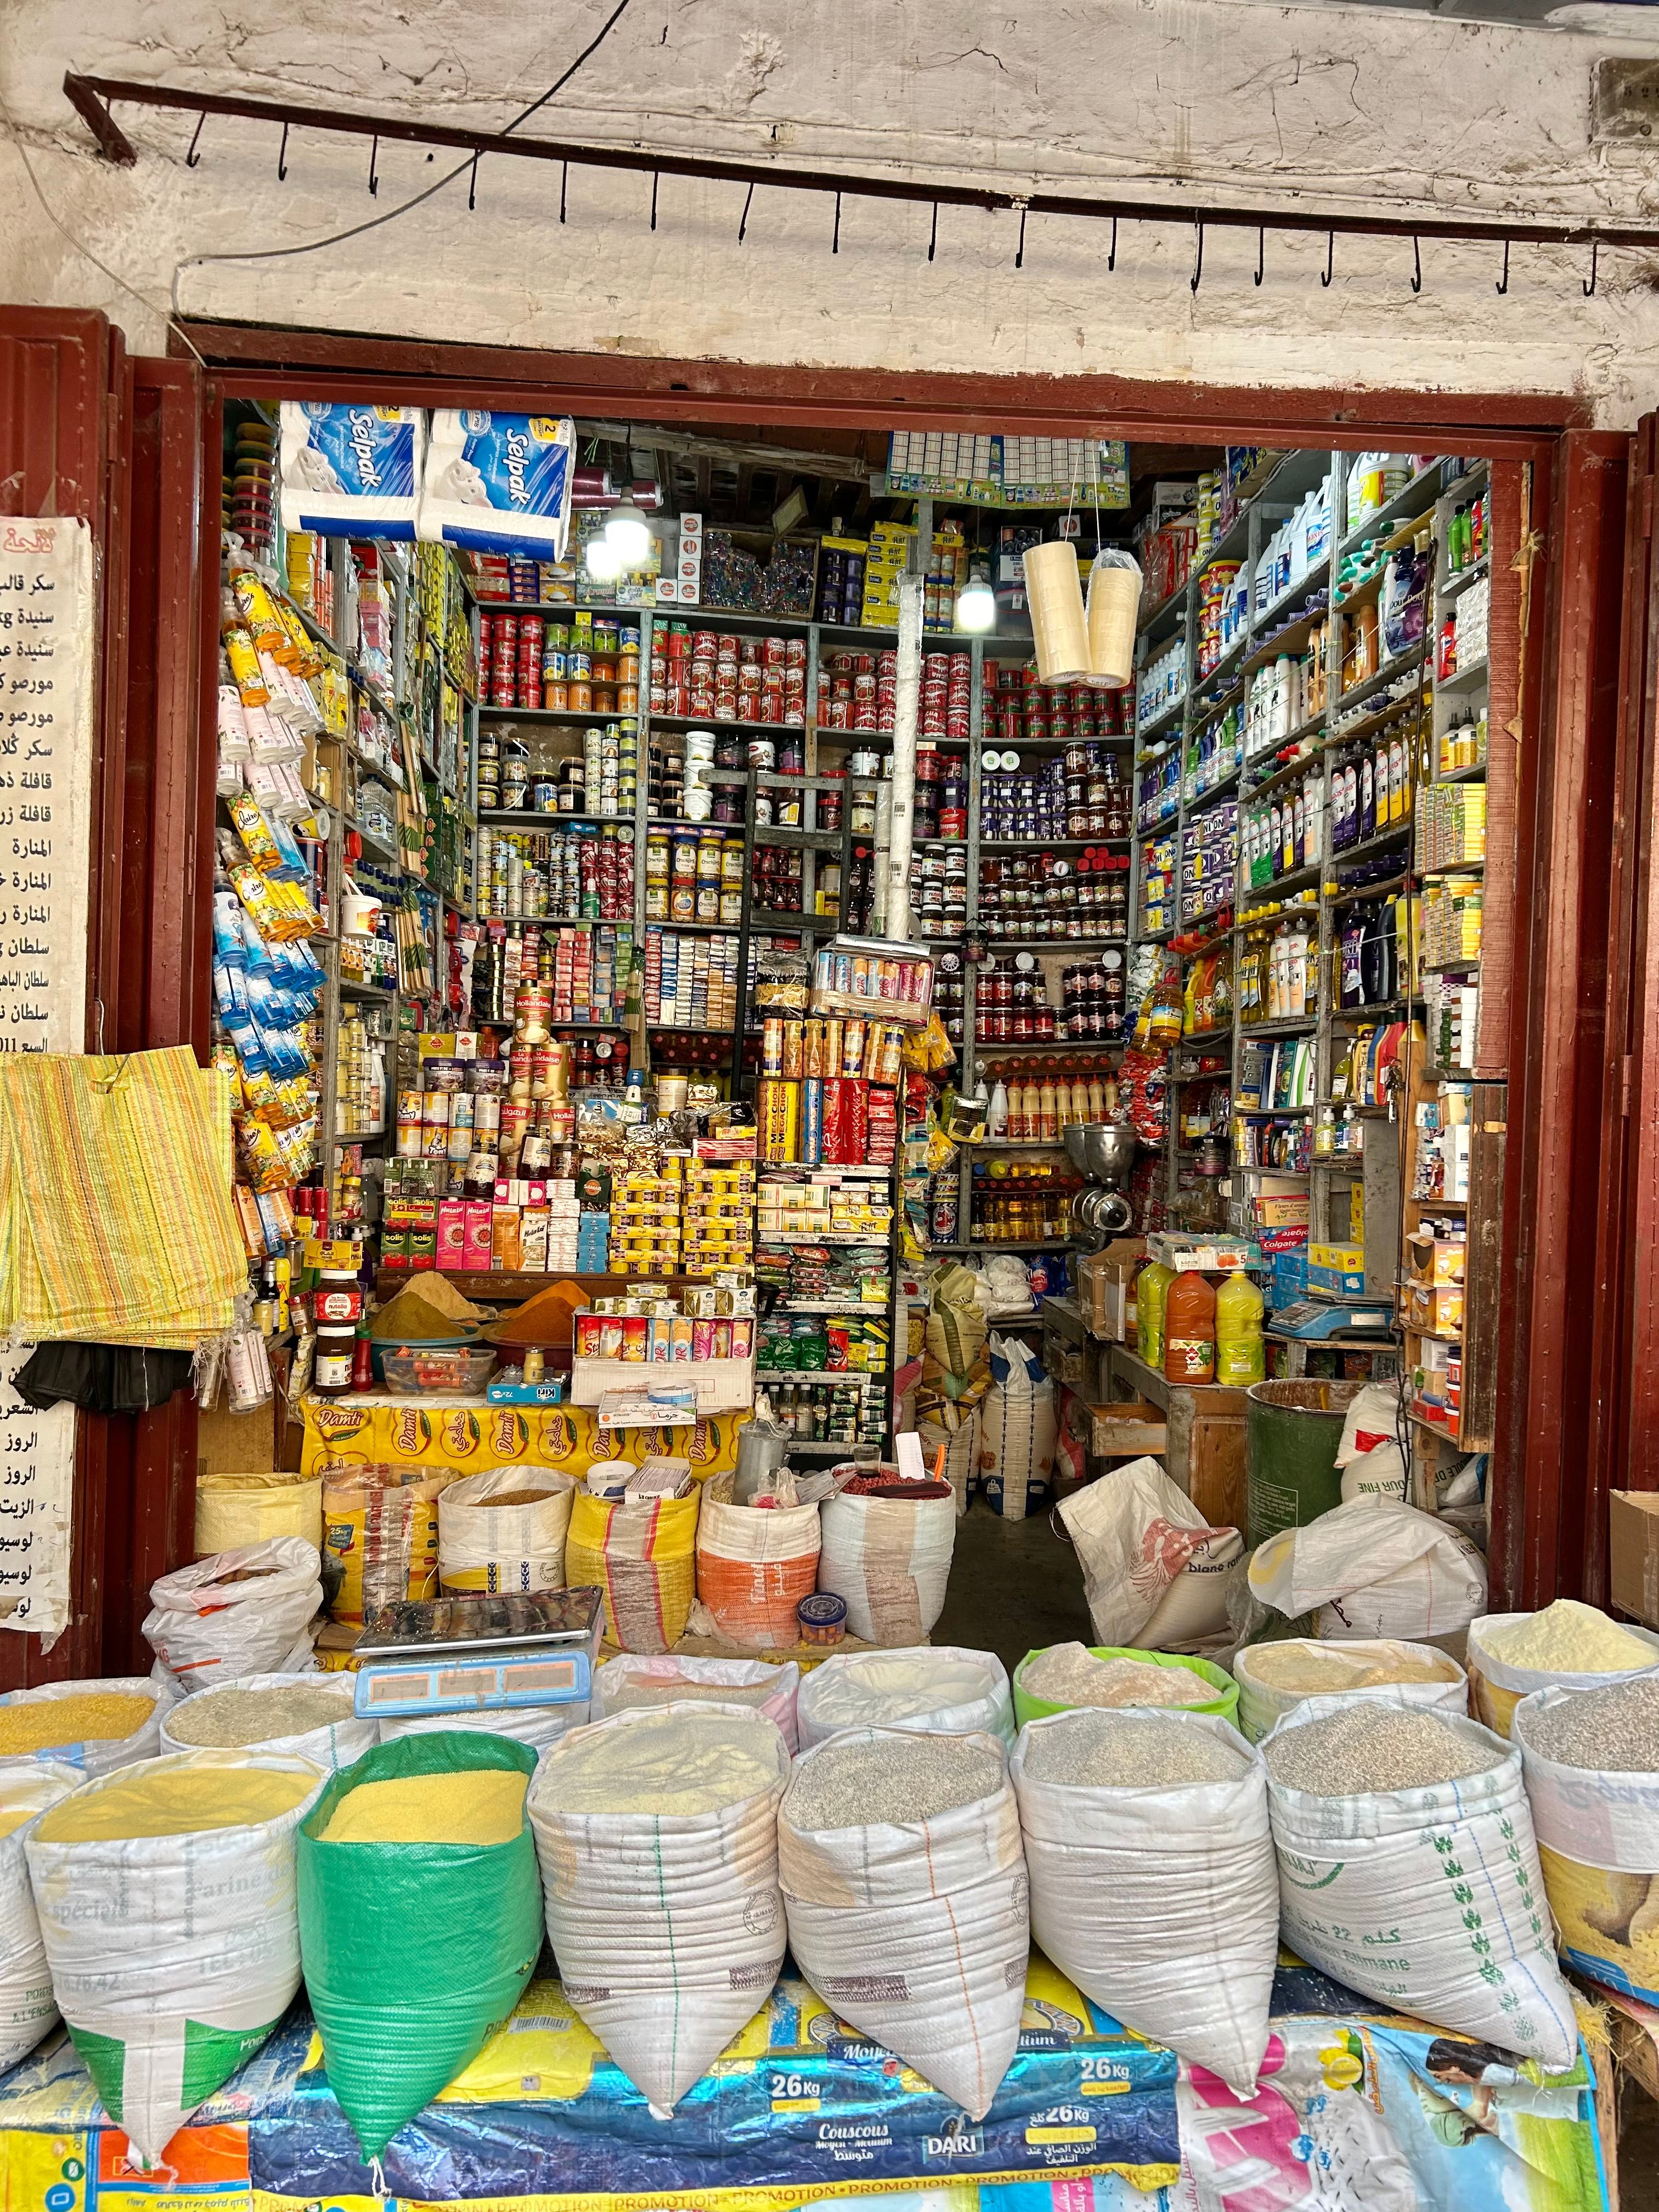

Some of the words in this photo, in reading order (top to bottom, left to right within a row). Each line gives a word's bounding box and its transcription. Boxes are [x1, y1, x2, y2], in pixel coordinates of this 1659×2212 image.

[544, 424, 556, 433] 2
[349, 409, 383, 488] Selpak
[503, 428, 532, 505] Selpak
[28, 574, 55, 596] سكر
[18, 607, 54, 629] سنيدة
[16, 641, 54, 662] سنيدة
[9, 678, 54, 695] مورصو
[7, 711, 54, 728] مورصو
[24, 739, 53, 760] سكر
[20, 772, 52, 789] قافلة
[19, 804, 52, 822] قافلة
[12, 838, 51, 858] المنارة
[12, 871, 51, 892] المنارة
[13, 904, 50, 926] المنارة
[8, 936, 49, 958] سلطان
[24, 969, 49, 991] سلطان
[10, 1002, 49, 1024] سلطان
[429, 1146, 447, 1155] Tomy
[446, 1180, 463, 1190] omy
[386, 1233, 404, 1241] solis
[413, 1233, 432, 1241] solis
[1282, 1228, 1308, 1238] olgate
[1263, 1240, 1297, 1249] Colgate
[1240, 1254, 1246, 1264] 5
[318, 1409, 365, 1426] Damti
[398, 1408, 417, 1451] Damti
[495, 1409, 516, 1454] Damti
[4, 1431, 38, 1452] الروز
[4, 1464, 36, 1486] الروز
[0, 1498, 34, 1520] الزيت
[0, 1531, 33, 1554] لوسيو
[0, 1564, 32, 1585] لوسيو
[1188, 1561, 1224, 1573] blanc
[818, 2123, 889, 2140] Couscous
[833, 2149, 874, 2162] متوسط
[927, 2136, 977, 2156] DARI
[848, 2177, 953, 2194] PROMOTION
[966, 2170, 1069, 2186] PROMOTION
